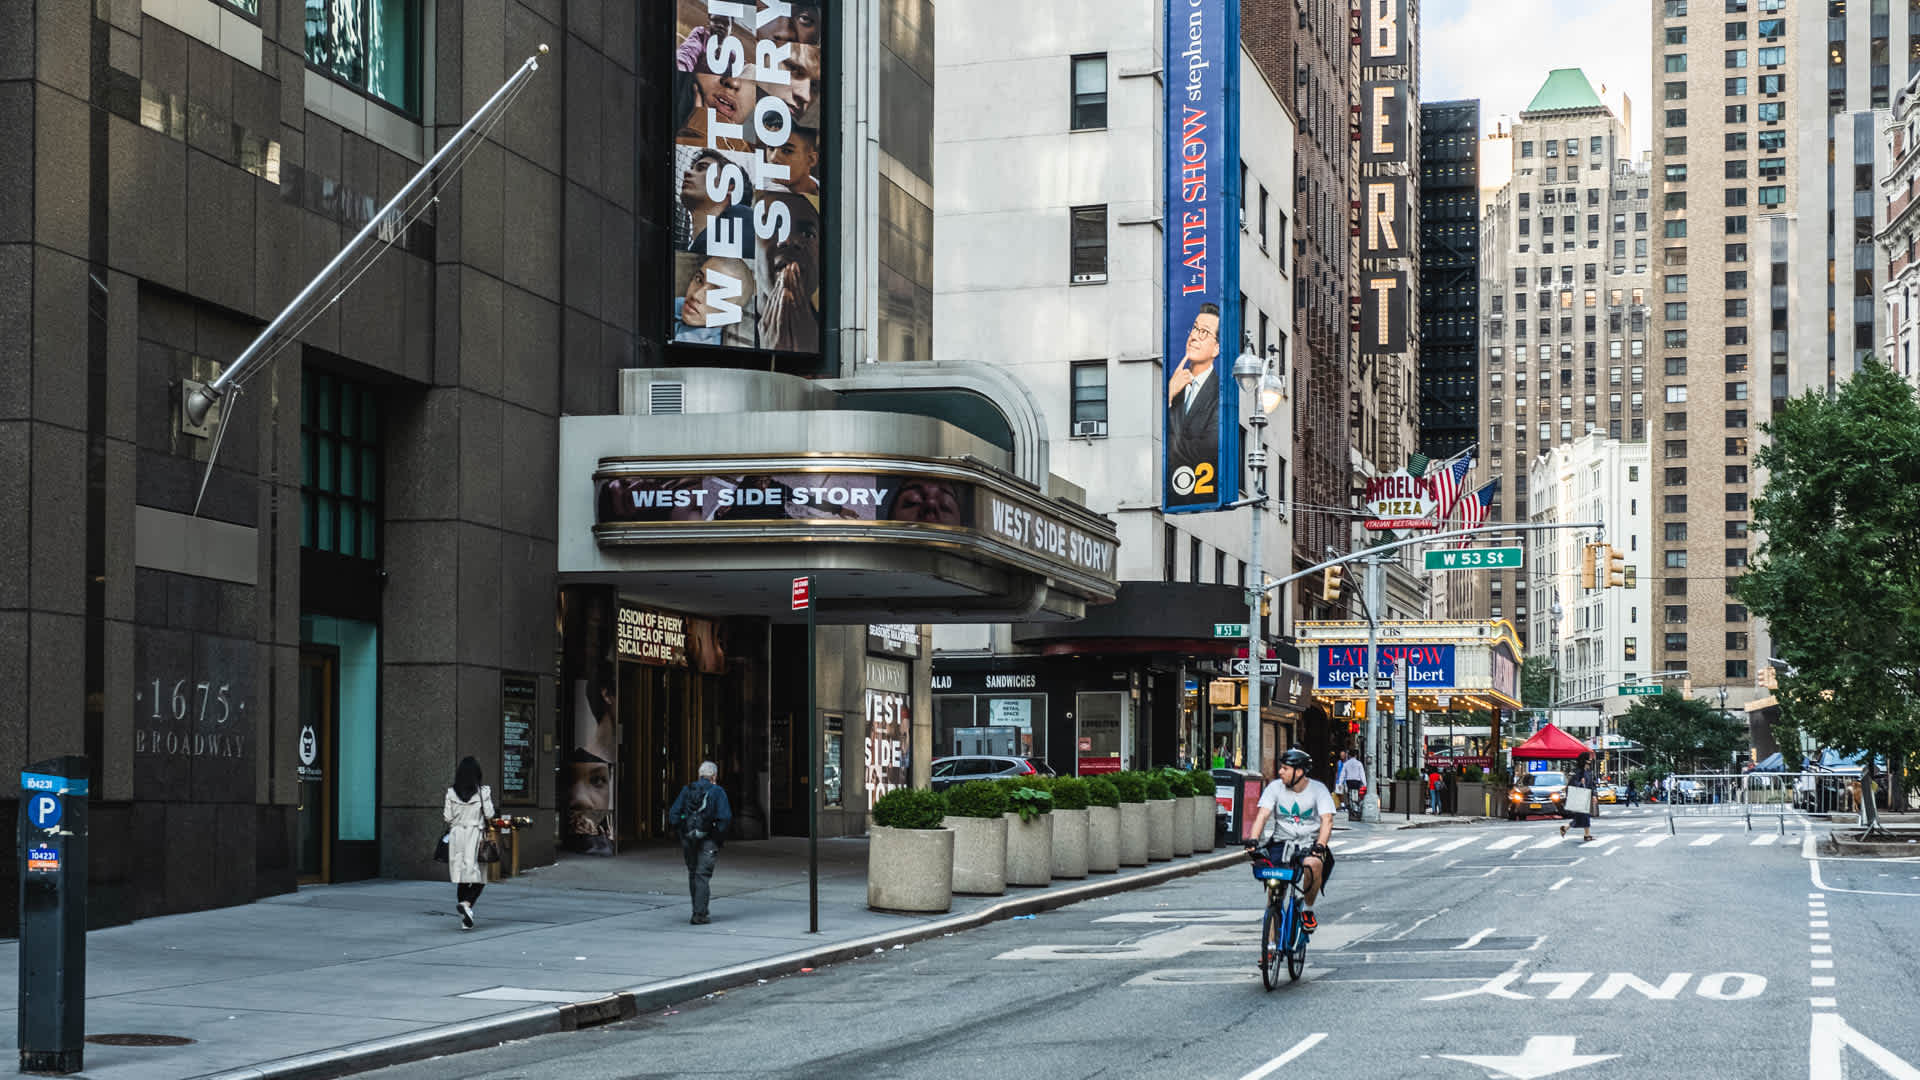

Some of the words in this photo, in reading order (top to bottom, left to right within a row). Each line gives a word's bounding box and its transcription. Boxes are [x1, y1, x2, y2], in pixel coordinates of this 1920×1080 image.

[1181, 9, 1210, 102] stephen
[753, 0, 793, 243] STORY
[1182, 104, 1207, 202] SHOW
[706, 108, 744, 329] WEST
[1182, 207, 1208, 297] LATE
[632, 489, 708, 508] WEST
[718, 488, 782, 506] SIDE
[791, 487, 889, 505] STORY
[1379, 501, 1422, 515] PIZZA
[992, 498, 1031, 543] WEST
[1035, 517, 1066, 557] SIDE
[1070, 530, 1108, 573] STORY
[1443, 553, 1456, 566] W
[1461, 552, 1481, 565] 53
[1487, 552, 1504, 564] St
[645, 613, 657, 628] OF
[658, 616, 682, 633] EVERY
[1216, 625, 1222, 635] W
[1224, 625, 1232, 636] 53
[1382, 627, 1401, 637] CBS
[618, 638, 641, 655] SICAL
[642, 642, 660, 658] CAN
[633, 627, 652, 642] IDEA
[652, 629, 664, 644] OF
[664, 633, 686, 648] WHAT
[1328, 647, 1379, 666] LAT
[1382, 647, 1446, 666] SHOW
[986, 675, 1035, 687] SANDWICHES
[1329, 666, 1387, 689] stephn
[1391, 666, 1444, 681] lbert
[152, 678, 230, 723] 1675
[136, 729, 245, 758] BROADWAY
[865, 737, 901, 768] SIDE
[39, 797, 55, 824] P
[31, 852, 55, 860] 104231
[1418, 960, 1769, 1000] ONLY
